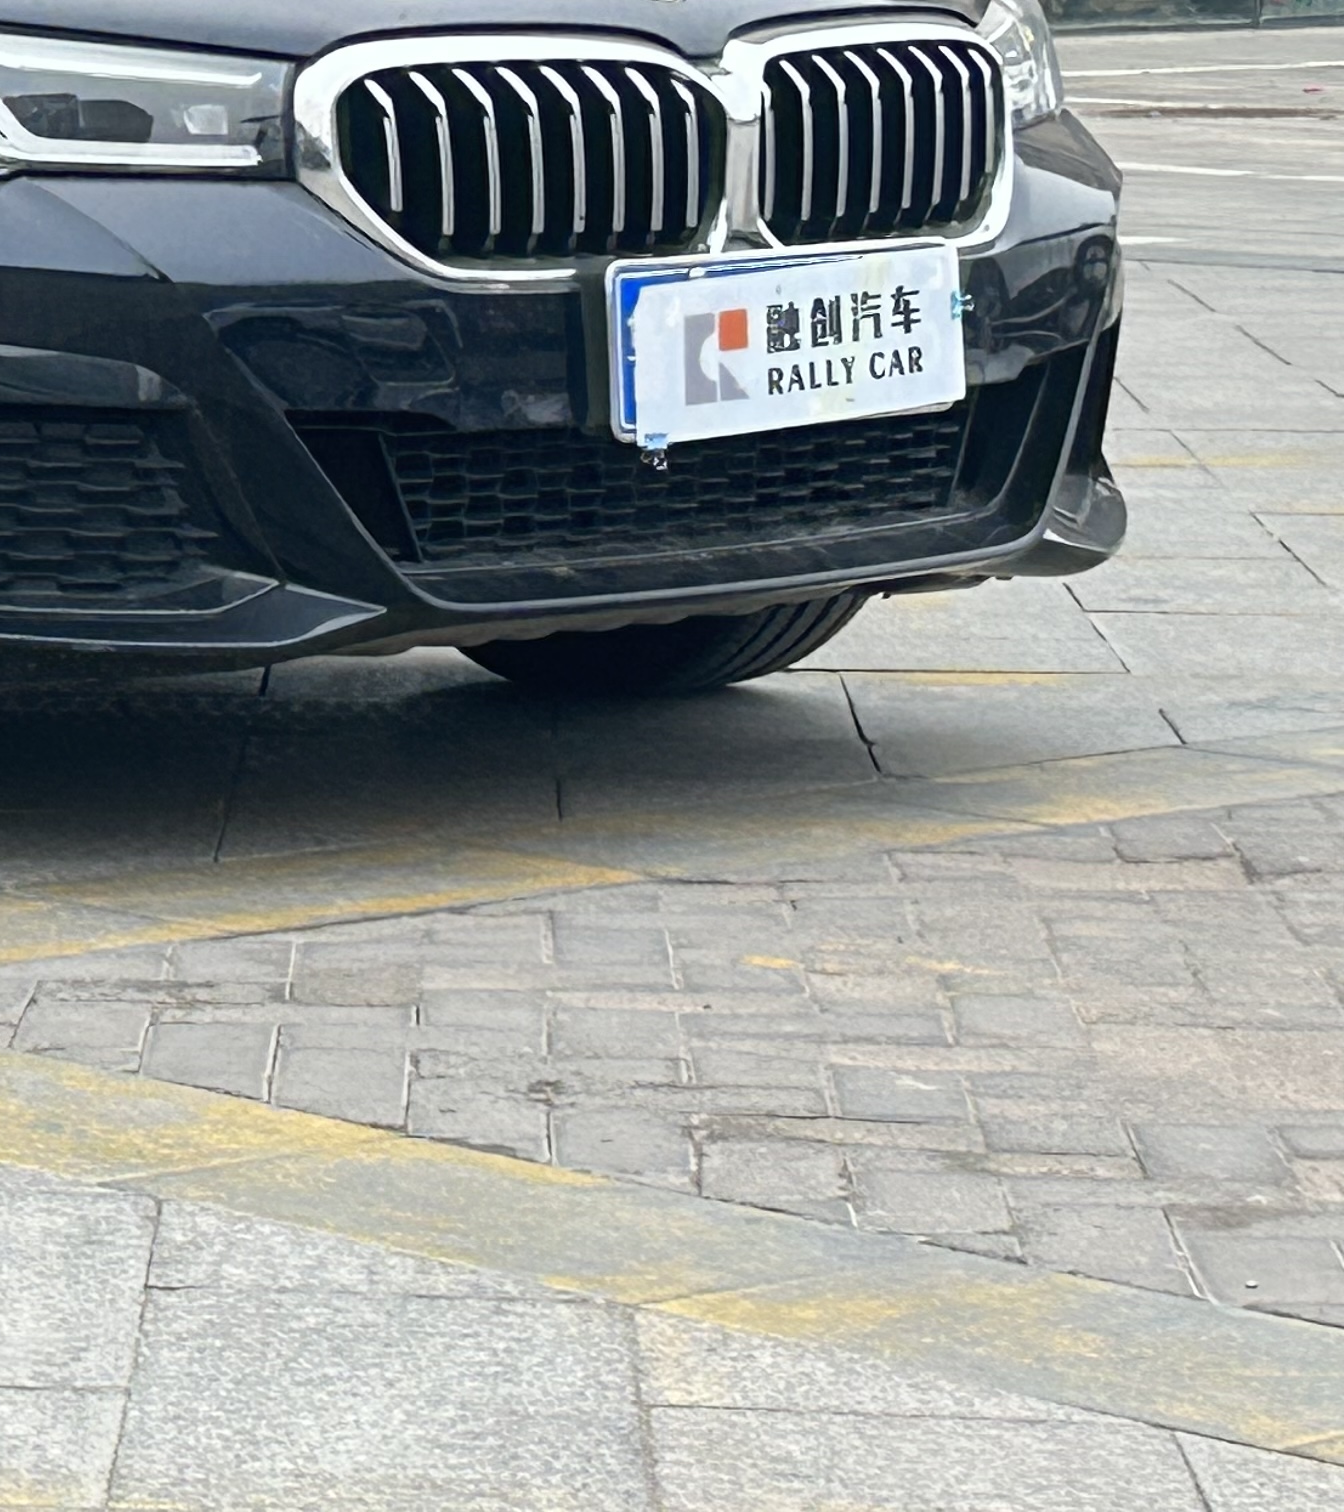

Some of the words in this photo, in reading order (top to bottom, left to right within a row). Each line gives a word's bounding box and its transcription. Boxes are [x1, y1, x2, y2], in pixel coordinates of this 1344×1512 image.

[766, 285, 921, 354] 融创汽车
[767, 356, 855, 395] RALLY
[869, 346, 923, 379] CAR
